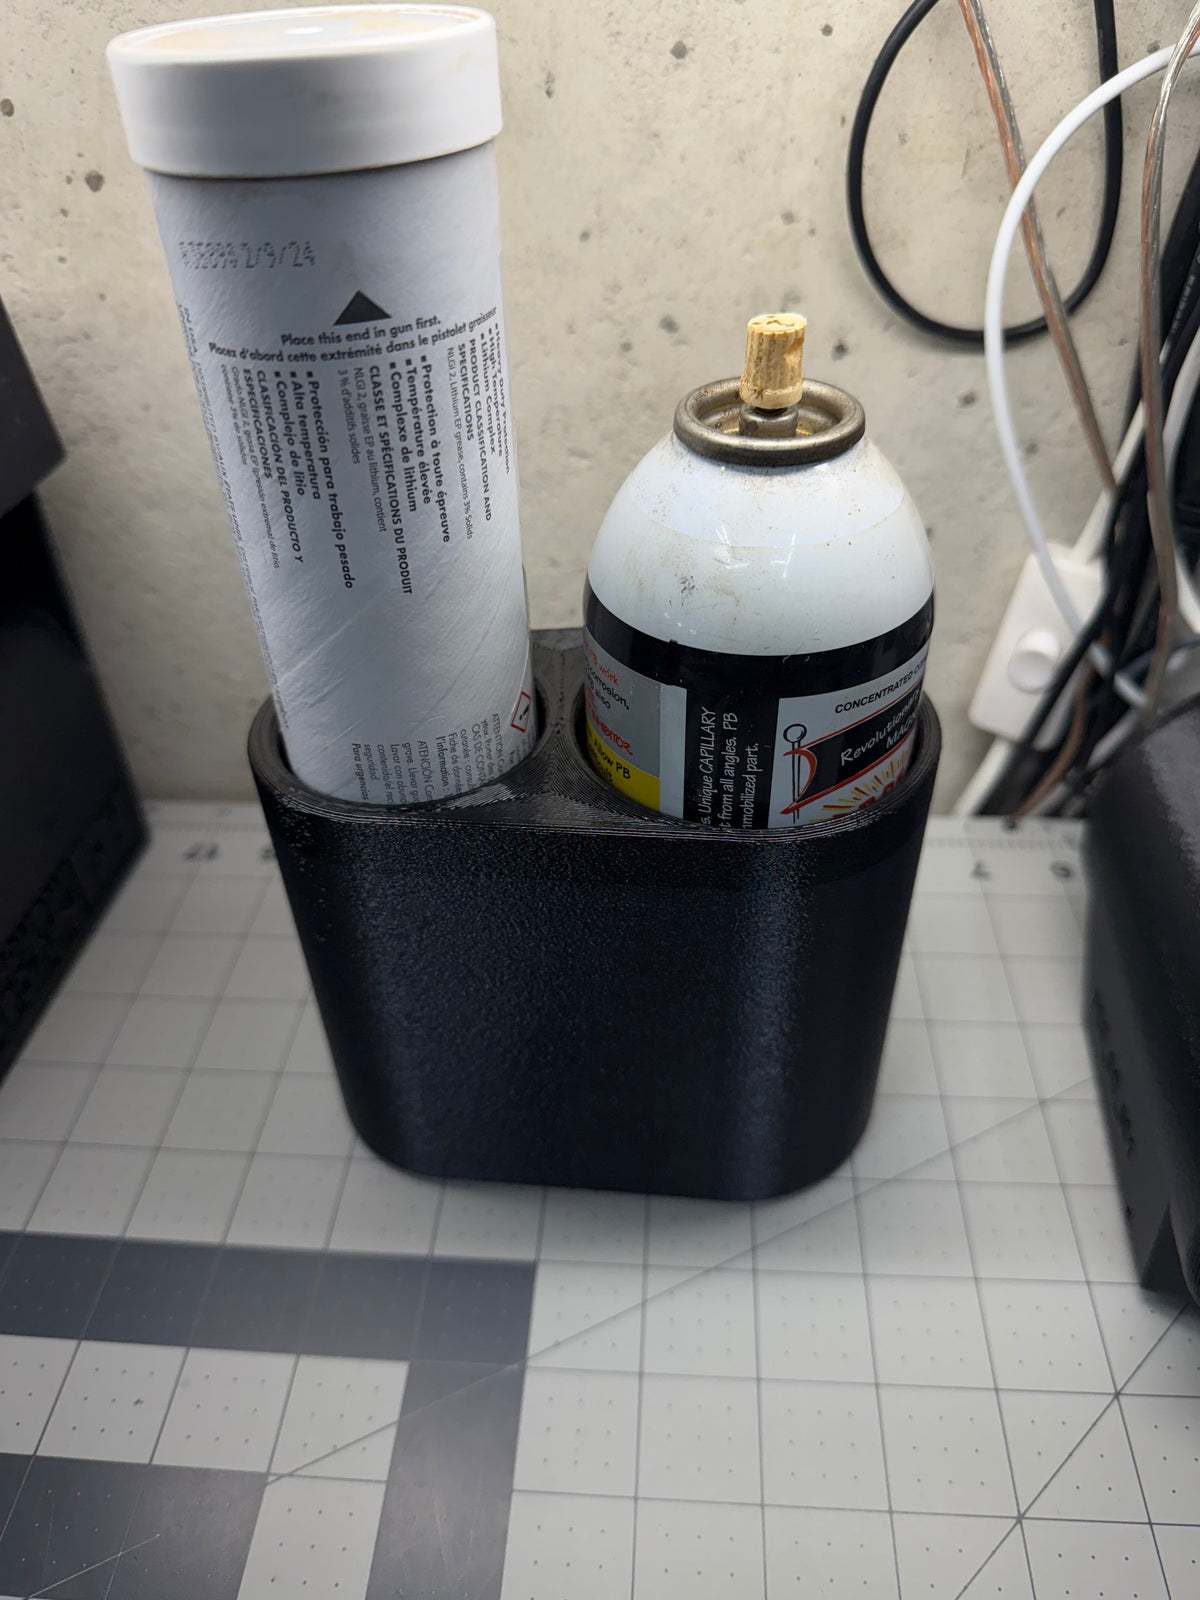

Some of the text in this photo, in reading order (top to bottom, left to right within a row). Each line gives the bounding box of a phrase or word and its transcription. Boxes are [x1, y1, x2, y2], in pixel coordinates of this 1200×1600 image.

[239, 347, 284, 362] d'abord
[287, 351, 316, 363] cette
[320, 344, 383, 361] extrémité
[386, 339, 415, 353] dans
[418, 335, 429, 346] le
[431, 322, 467, 346] pistolet
[280, 315, 441, 346] Place this end in gun first.
[339, 377, 350, 387] %
[458, 343, 475, 441] SPECIFICATIONS
[481, 342, 497, 455] Lithium Complex
[489, 337, 503, 457] High Temperature
[234, 422, 241, 432] de
[243, 368, 274, 479] ESPECIFICACIONES
[341, 388, 357, 431] d'additifs
[469, 338, 492, 521] PRODUCT CLASSIFICATION AND
[276, 380, 307, 496] Complejo de litio
[291, 381, 321, 499] Alta temperatura
[349, 433, 362, 465] solides
[353, 367, 388, 533] NLGI 2, graisse EP au lithium, contient
[391, 371, 418, 512] Complexe de lithium
[407, 367, 433, 504] Température élevée
[422, 364, 451, 543] Protection à toute épreuve
[446, 346, 474, 540] NLGI 2, Lithium EP grease, contains 3% Solids
[502, 411, 510, 474] Protection
[251, 455, 259, 466] EP
[257, 370, 304, 564] CLASIFICACIÓN DEL PRODUCTO Y
[369, 365, 413, 594] CLASSE ET SPÉCIFICATIONS DU PRODUIT
[252, 467, 266, 502] (presión
[308, 381, 356, 589] Protección para trabajo pesado
[261, 503, 275, 540] extrema)
[269, 540, 278, 552] de
[599, 664, 619, 687] work
[834, 670, 913, 714] CONCENTRATED
[448, 732, 459, 753] Fiche
[472, 723, 482, 741] CAS
[492, 713, 504, 759] ATTENTION
[699, 706, 717, 774] CAPILLARY
[722, 712, 738, 730] PB
[363, 743, 381, 782] seguridad.
[377, 744, 395, 790] contenido/el
[390, 743, 401, 764] Lavar
[402, 742, 414, 765] grave.
[408, 767, 420, 789] Llevar
[417, 740, 433, 784] ATENCIÓN
[436, 735, 451, 787] l'information
[451, 755, 461, 765] de
[474, 741, 483, 754] DE
[720, 737, 741, 777] angles.
[745, 743, 764, 771] part.
[351, 743, 371, 801] Para urgencias
[394, 765, 404, 780] con
[615, 761, 631, 780] PB
[719, 778, 735, 793] all
[698, 775, 719, 813] Unique
[717, 794, 733, 820] from
